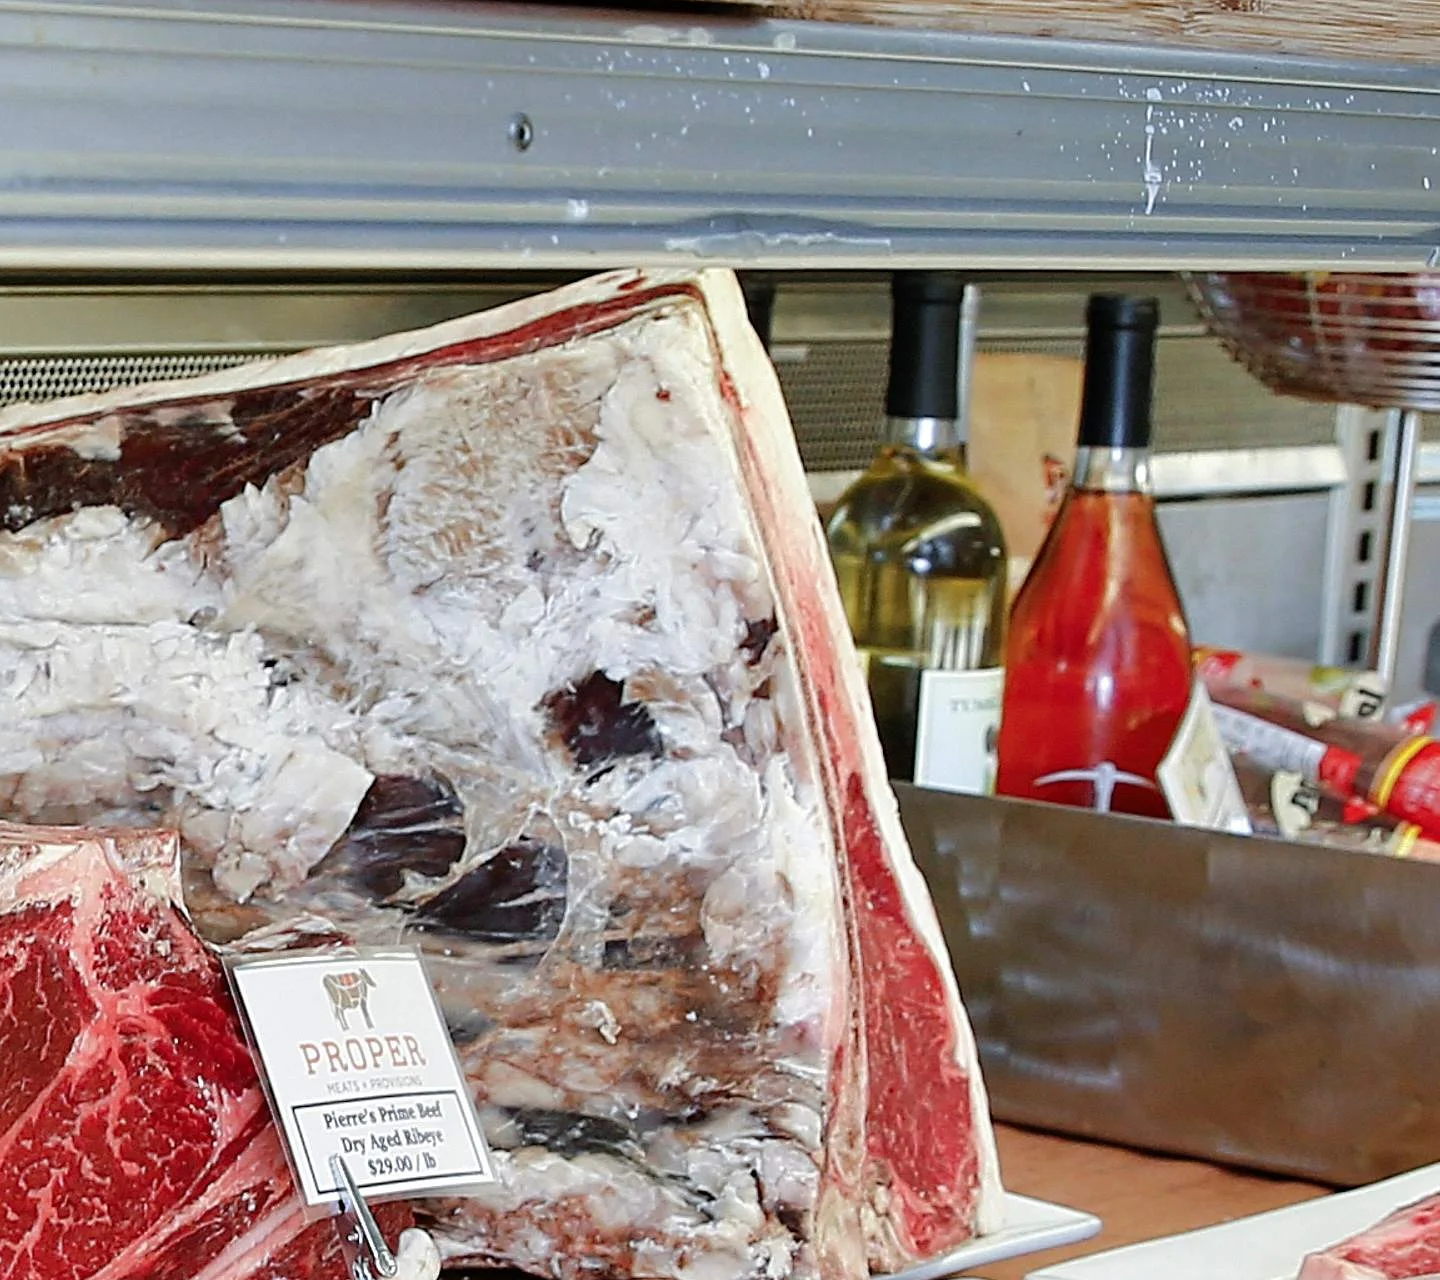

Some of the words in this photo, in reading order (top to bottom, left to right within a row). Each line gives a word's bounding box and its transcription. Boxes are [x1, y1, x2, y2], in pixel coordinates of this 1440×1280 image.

[299, 1035, 427, 1075] PROPER
[323, 1107, 377, 1129] Pierre's
[379, 1103, 416, 1123] Prime
[418, 1100, 443, 1119] Beef
[341, 1136, 367, 1156] Dry
[370, 1131, 402, 1152] Aged
[405, 1126, 444, 1147] Ribeye
[367, 1155, 414, 1176] $29.00
[423, 1152, 437, 1169] lb
